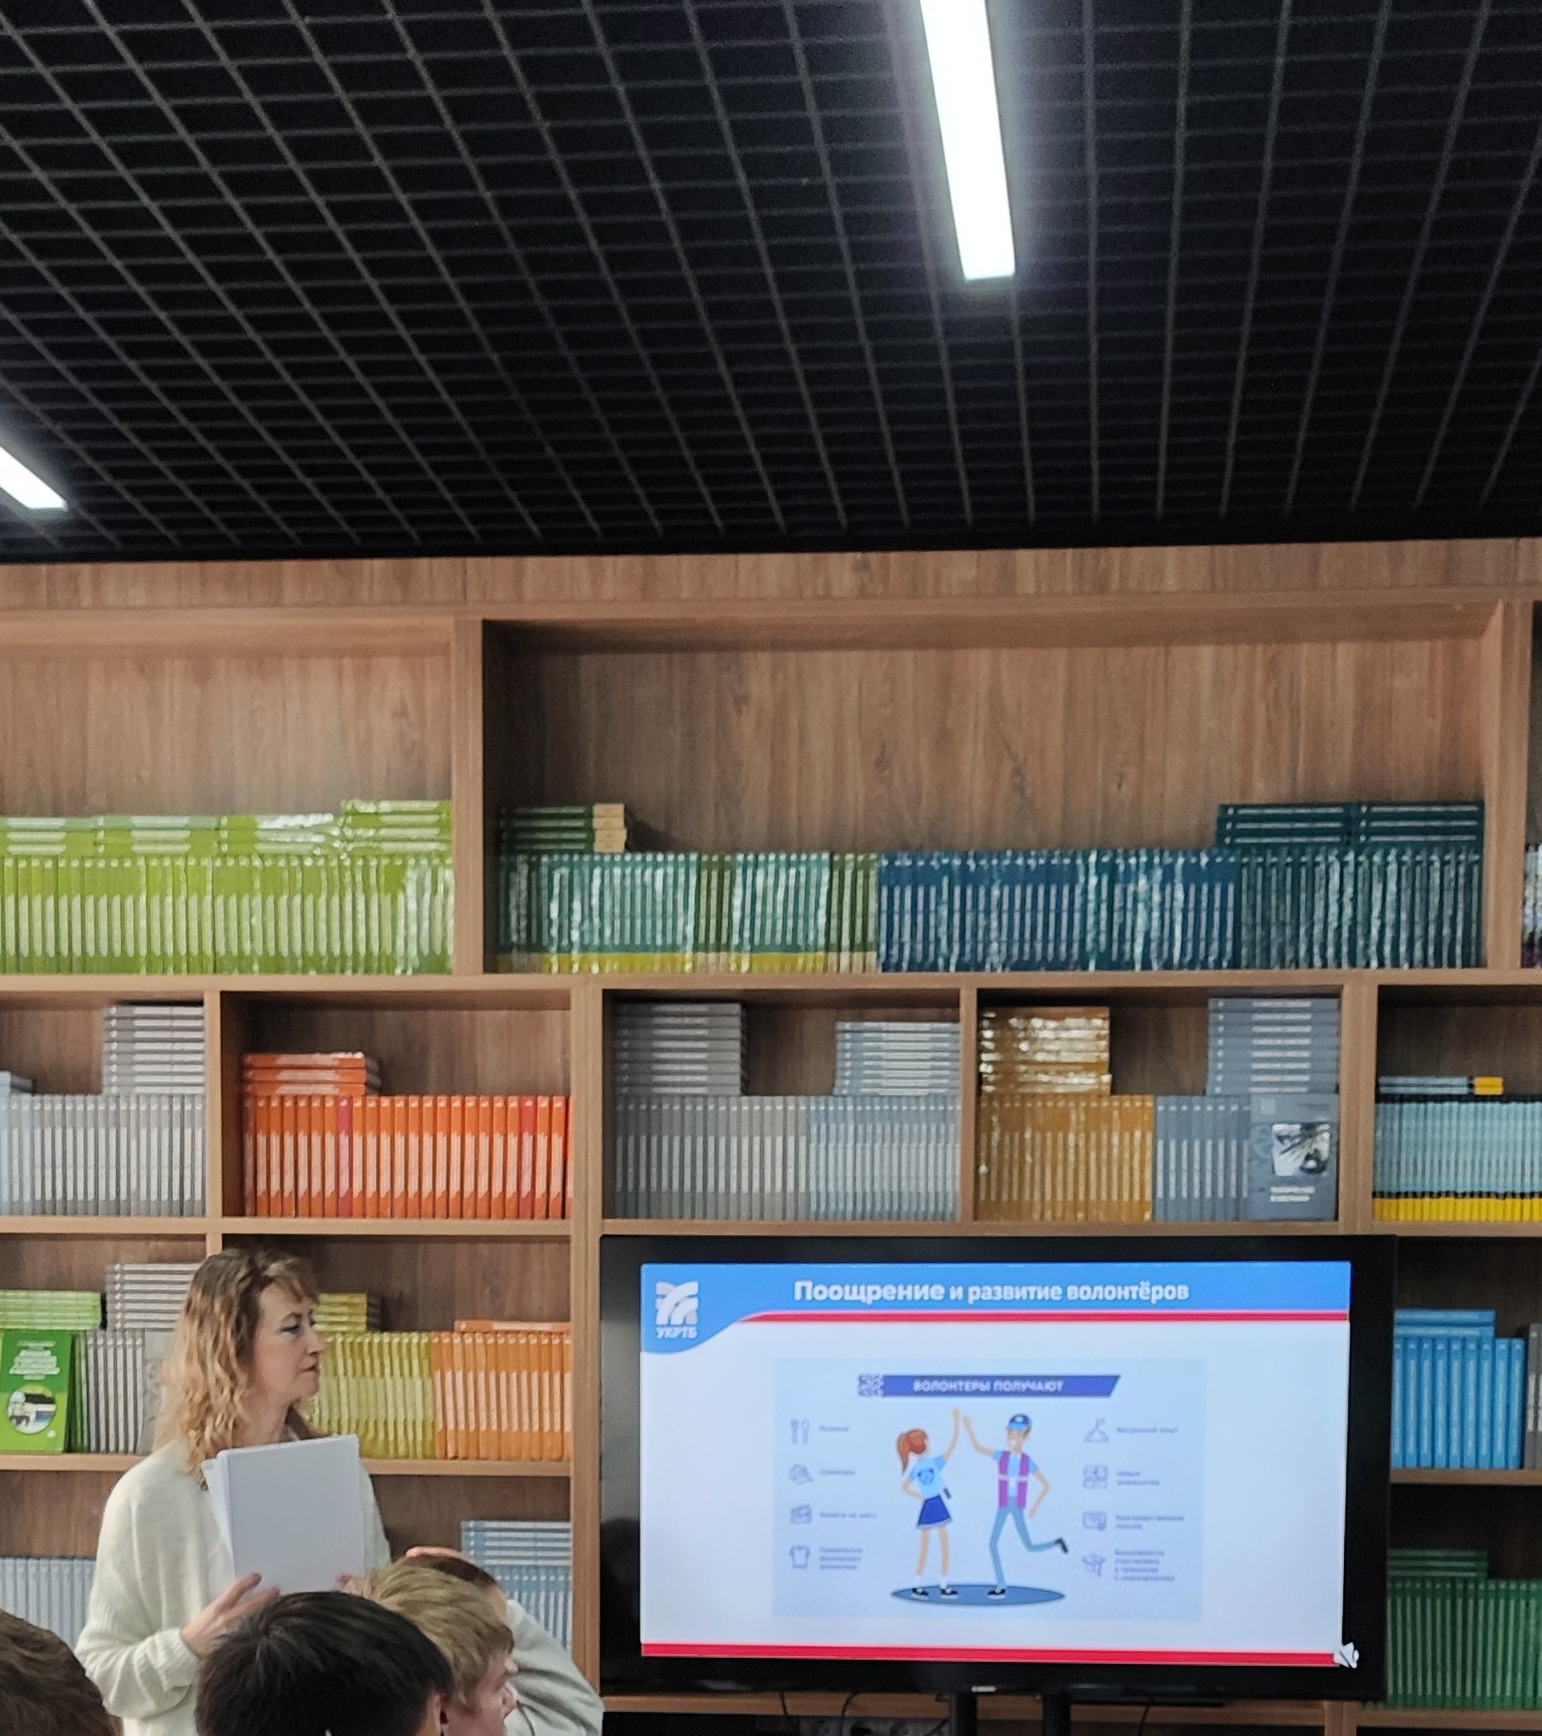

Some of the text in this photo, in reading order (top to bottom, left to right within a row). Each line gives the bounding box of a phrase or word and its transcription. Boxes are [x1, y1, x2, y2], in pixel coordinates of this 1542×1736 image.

[794, 1280, 1190, 1305] Поощрение и развитие волонтёров
[912, 1379, 1064, 1392] ВОЛОНТЕРЫ ПОЛУЧАЮТ
